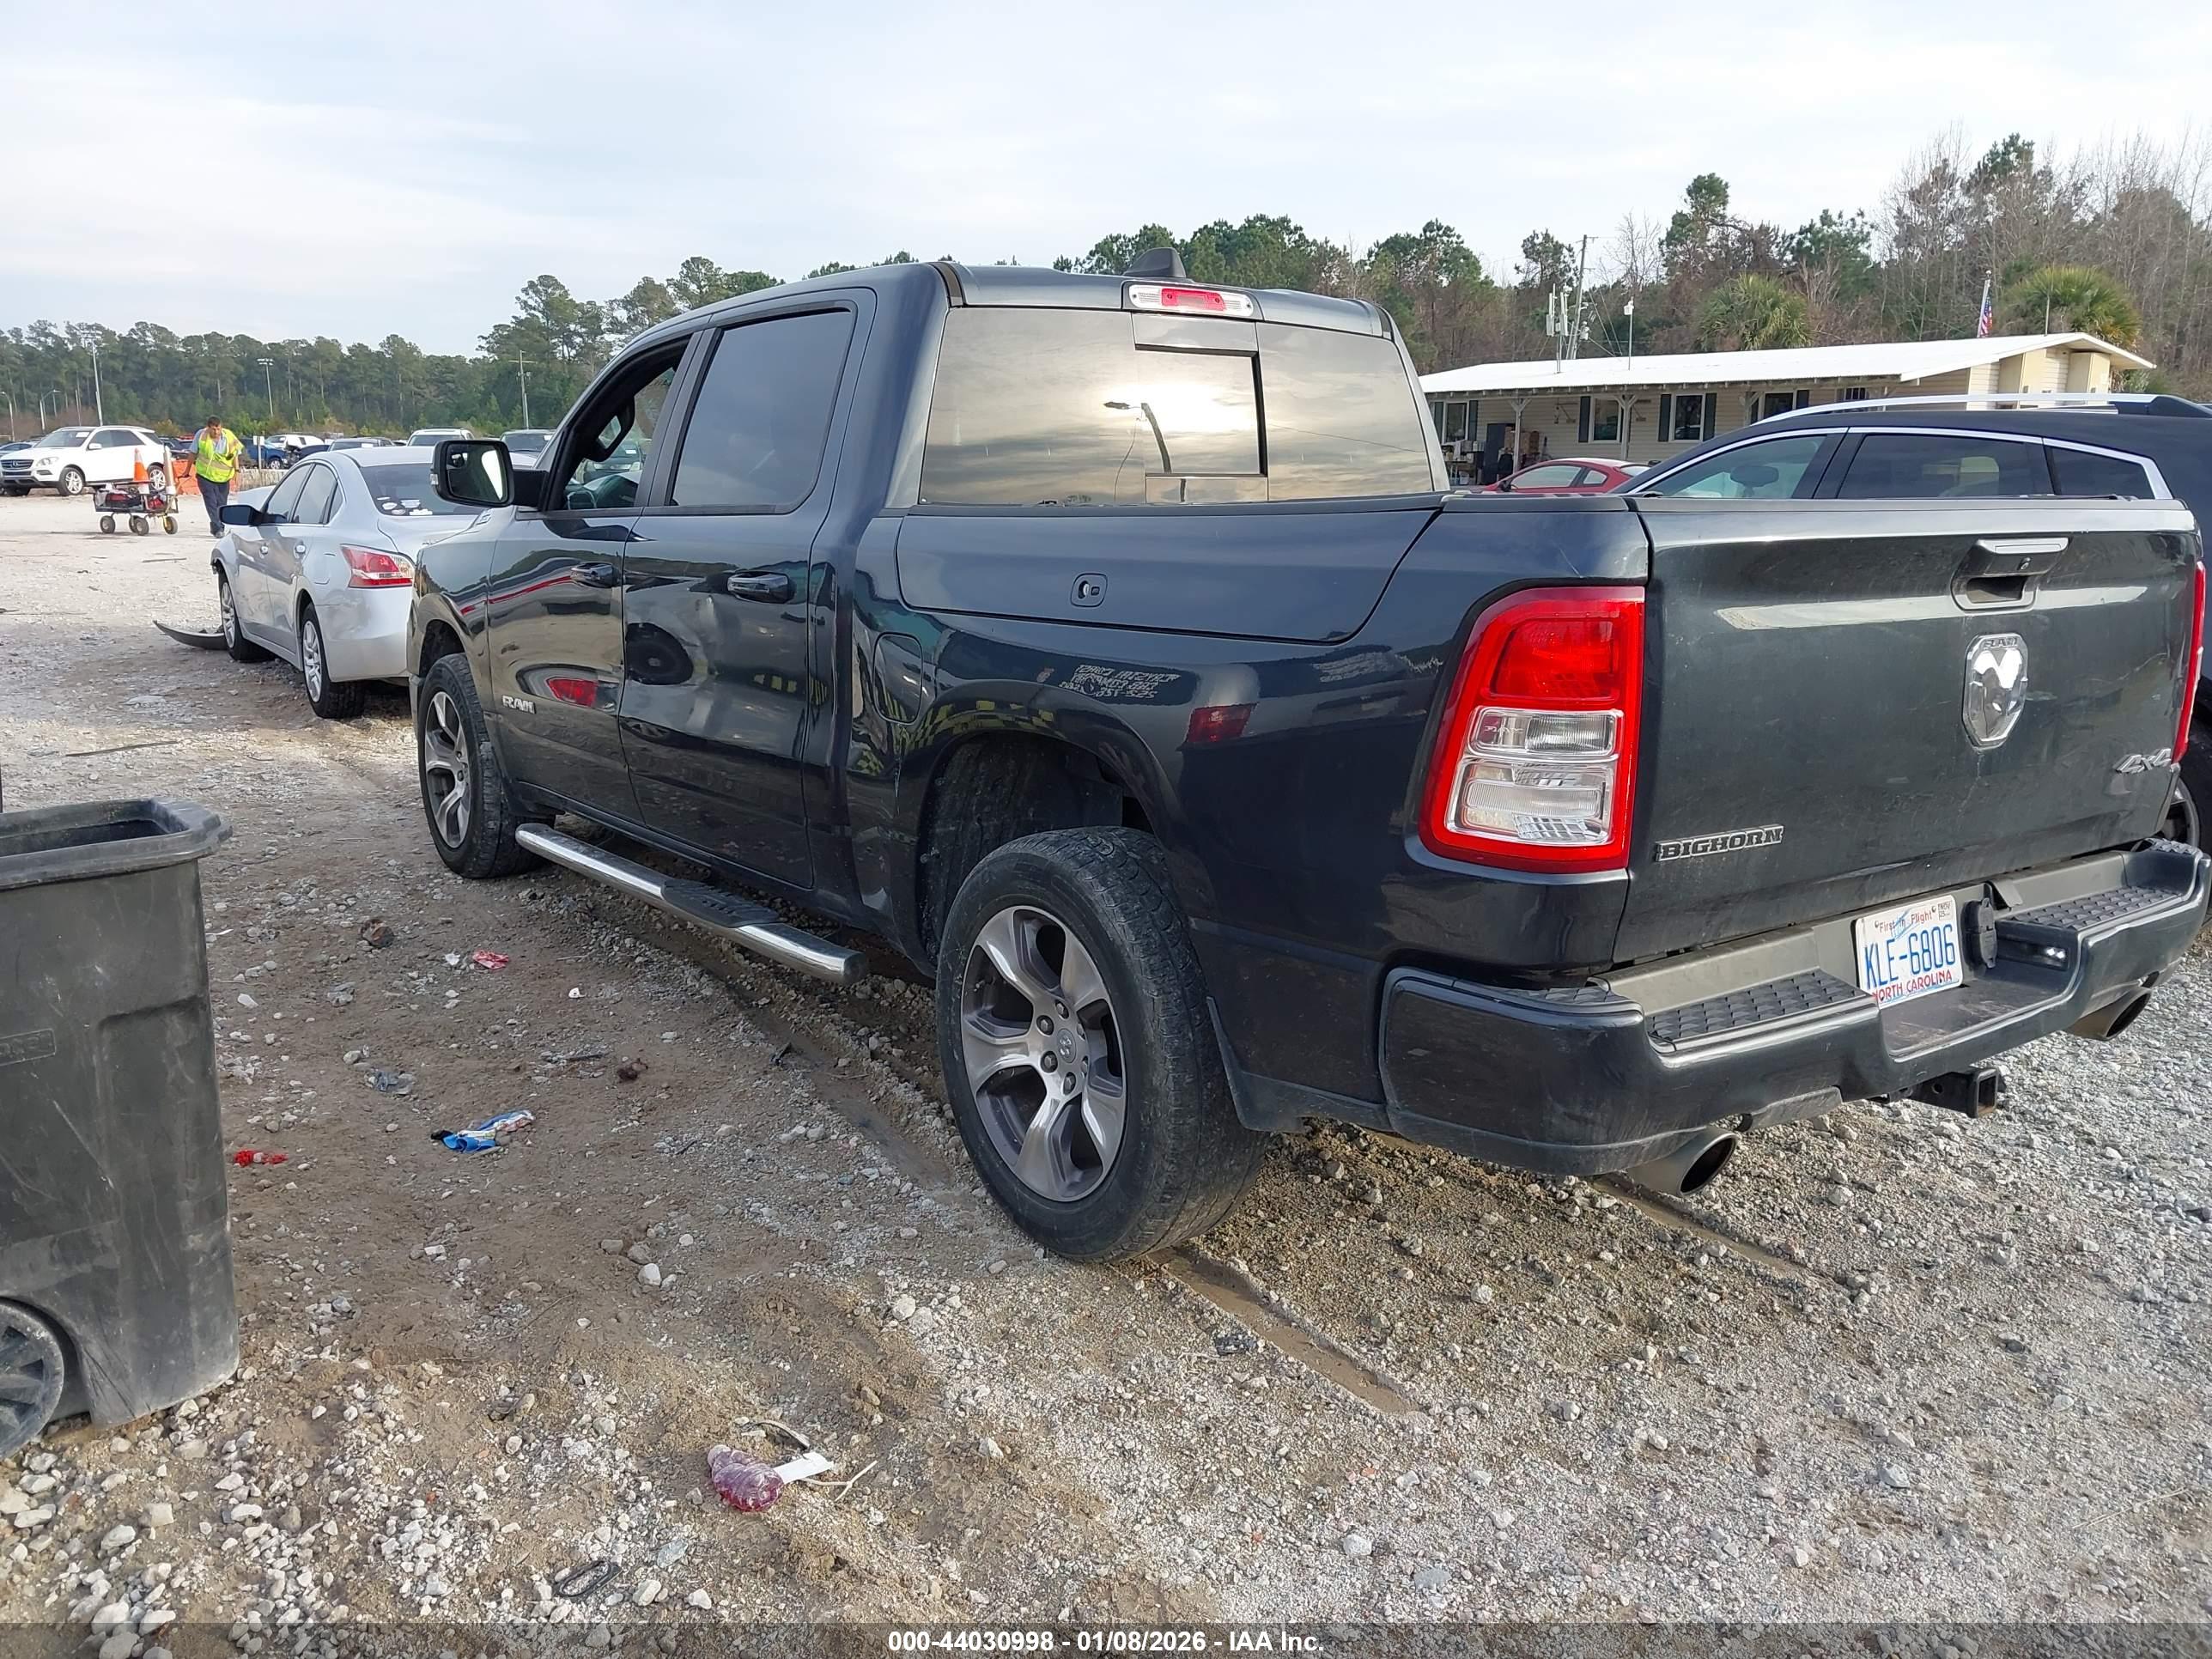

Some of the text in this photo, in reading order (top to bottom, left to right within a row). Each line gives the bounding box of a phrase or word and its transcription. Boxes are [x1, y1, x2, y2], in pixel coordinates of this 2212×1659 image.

[501, 695, 536, 714] RAM
[1659, 825, 1784, 862] BIGHORN
[1879, 921, 1896, 933] First
[1911, 909, 1933, 926] Flight
[1864, 923, 1956, 990] KLE-6806
[1906, 969, 1953, 994] CAROLINA
